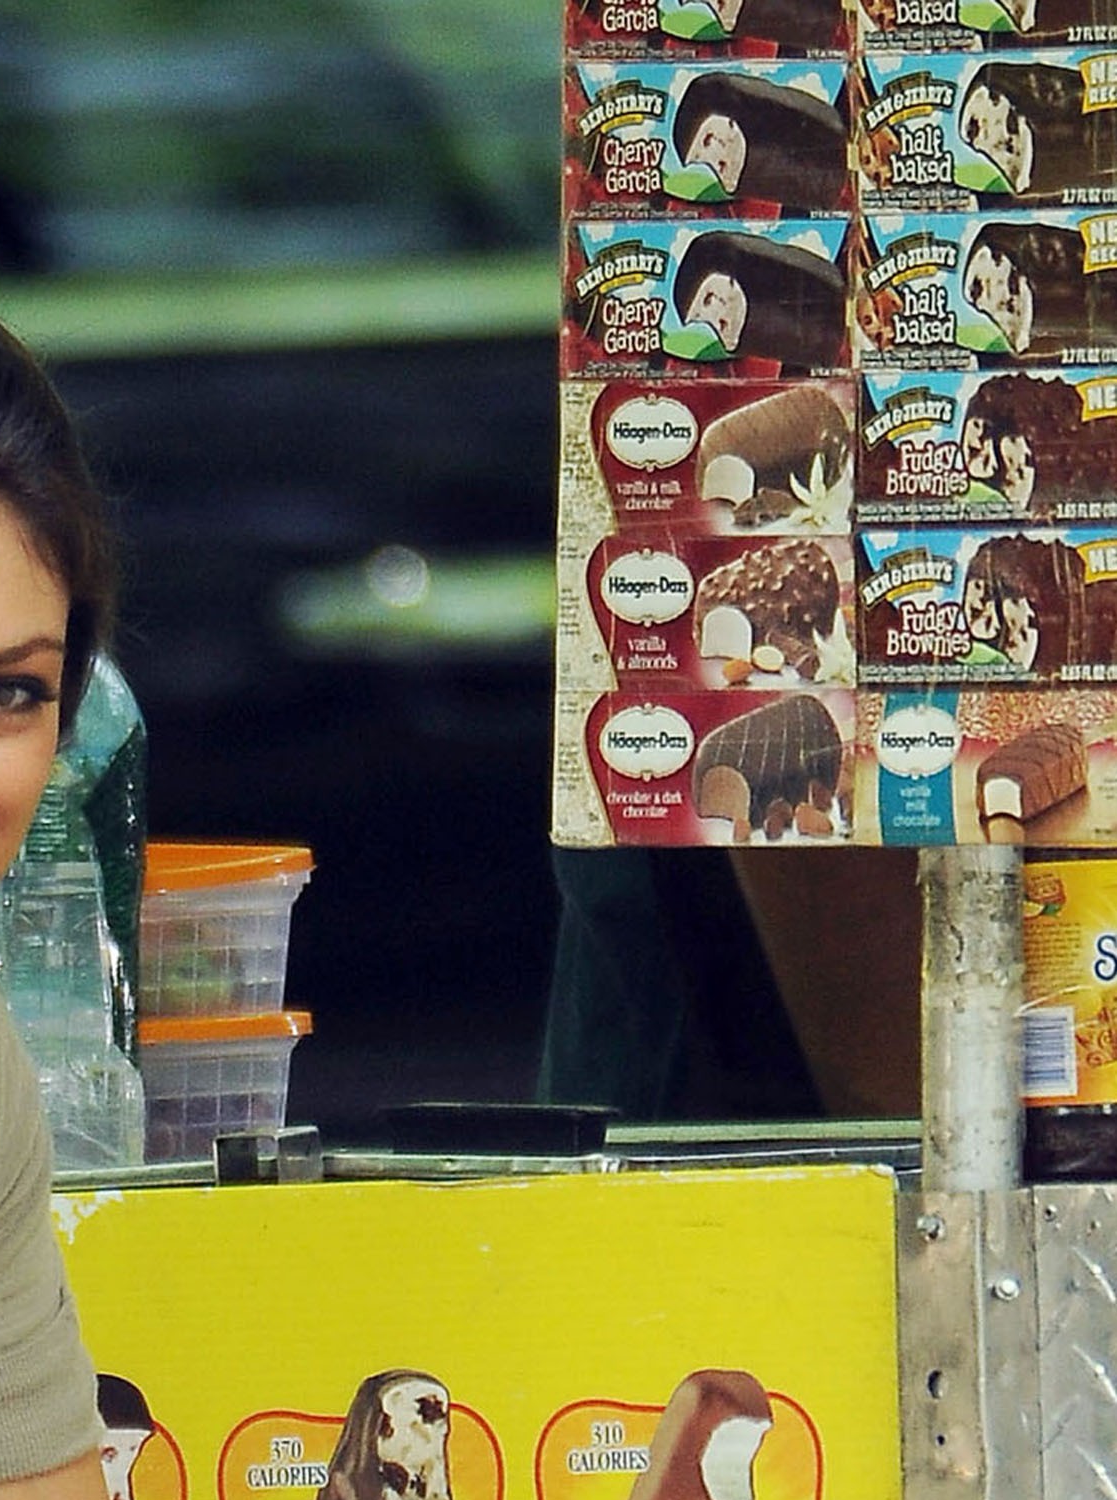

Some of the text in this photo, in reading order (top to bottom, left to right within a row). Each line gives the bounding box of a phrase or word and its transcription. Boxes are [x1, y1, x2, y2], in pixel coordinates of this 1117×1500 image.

[603, 7, 658, 32] Garcia
[896, 0, 956, 24] baked
[604, 139, 663, 165] Cherry
[900, 127, 943, 157] half
[605, 168, 661, 193] Garcia
[890, 155, 952, 185] baked
[603, 300, 664, 326] Cherry
[904, 288, 945, 317] half
[604, 329, 660, 354] Garcia
[893, 314, 954, 344] baked
[900, 444, 956, 473] Fudgy
[886, 470, 968, 496] Brownies
[901, 603, 960, 633] Fudgy
[887, 630, 971, 657] Brownies
[628, 654, 678, 670] almonds
[591, 1424, 623, 1447] 310
[271, 1440, 302, 1462] 370
[568, 1451, 648, 1472] CALORIES
[248, 1466, 328, 1488] CALORIES
